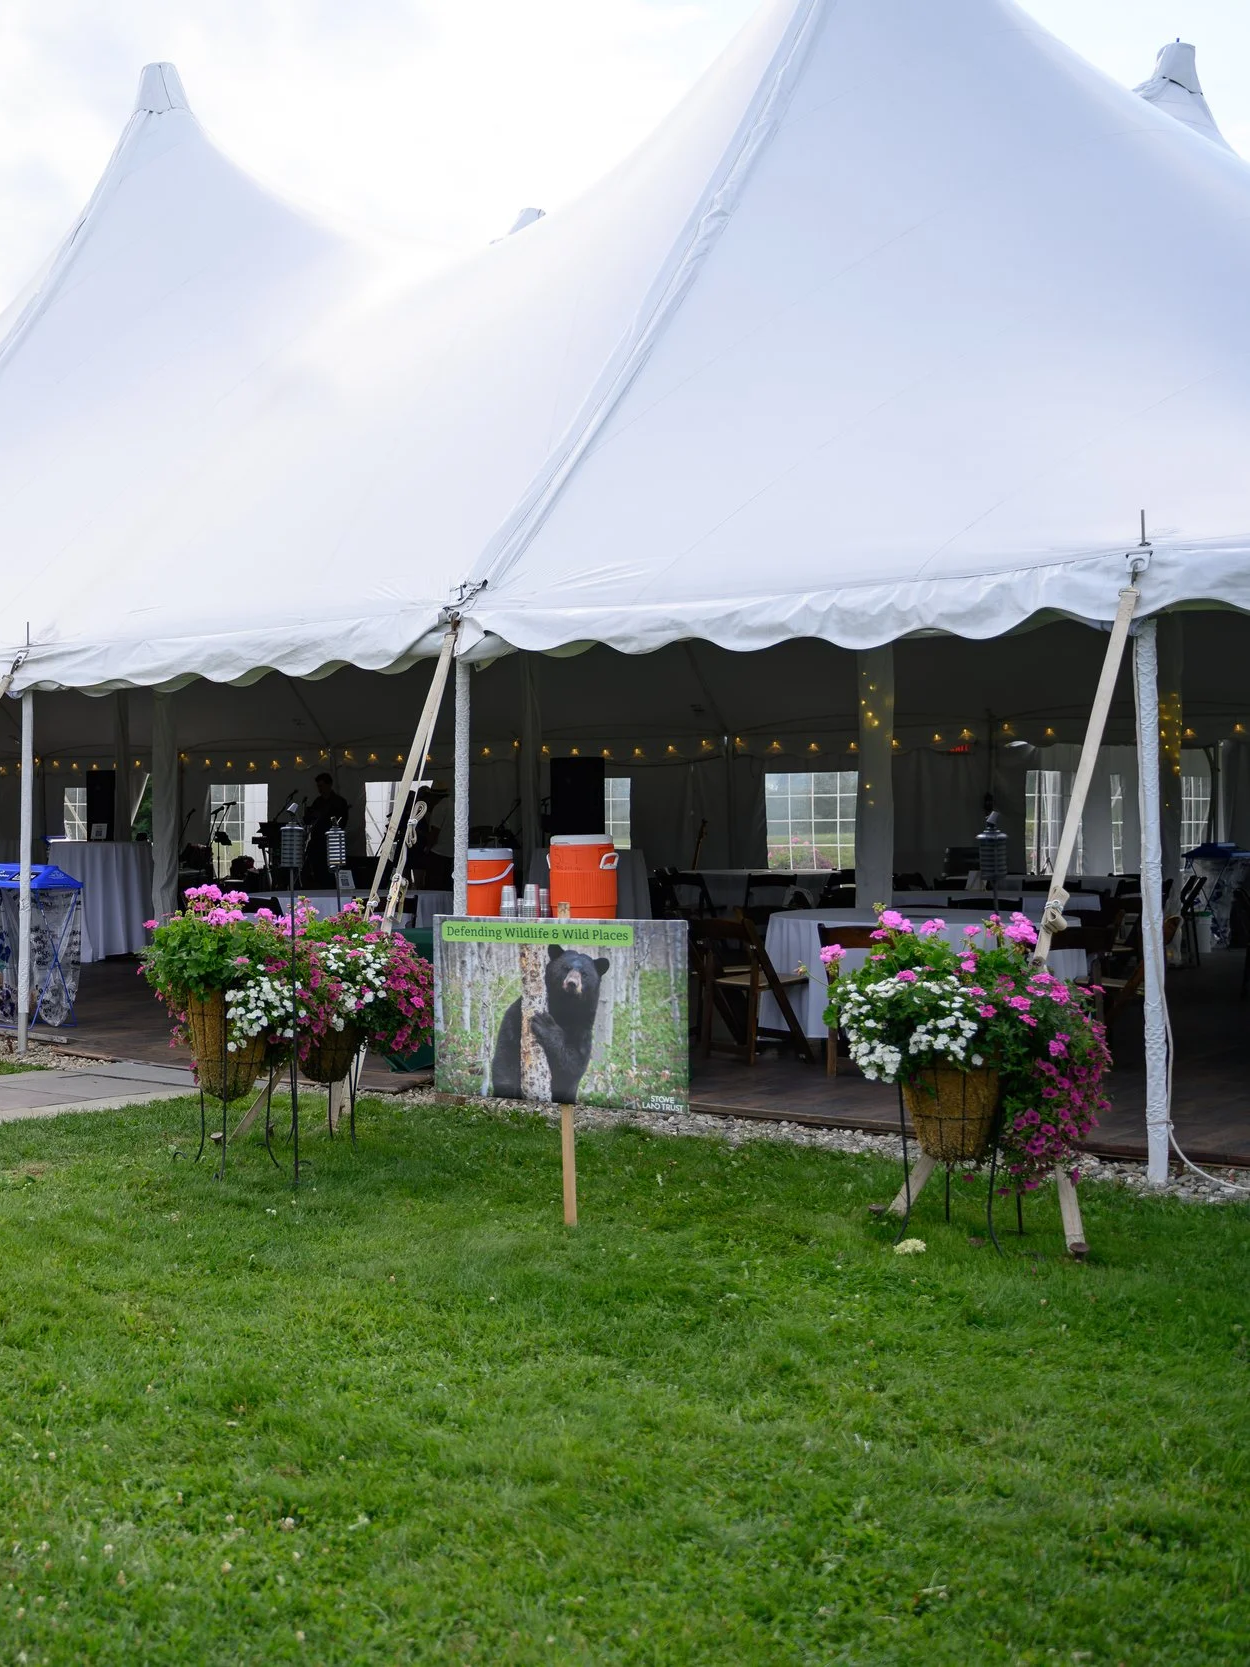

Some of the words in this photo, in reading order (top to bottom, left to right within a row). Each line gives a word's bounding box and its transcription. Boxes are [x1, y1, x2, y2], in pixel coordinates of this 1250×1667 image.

[446, 926, 502, 940] Defending
[504, 926, 549, 939] Wildlife
[552, 929, 559, 939] &
[562, 928, 590, 940] Wild
[592, 929, 629, 941] Places
[651, 1096, 674, 1104] STOWE
[661, 1104, 684, 1112] TRUST
